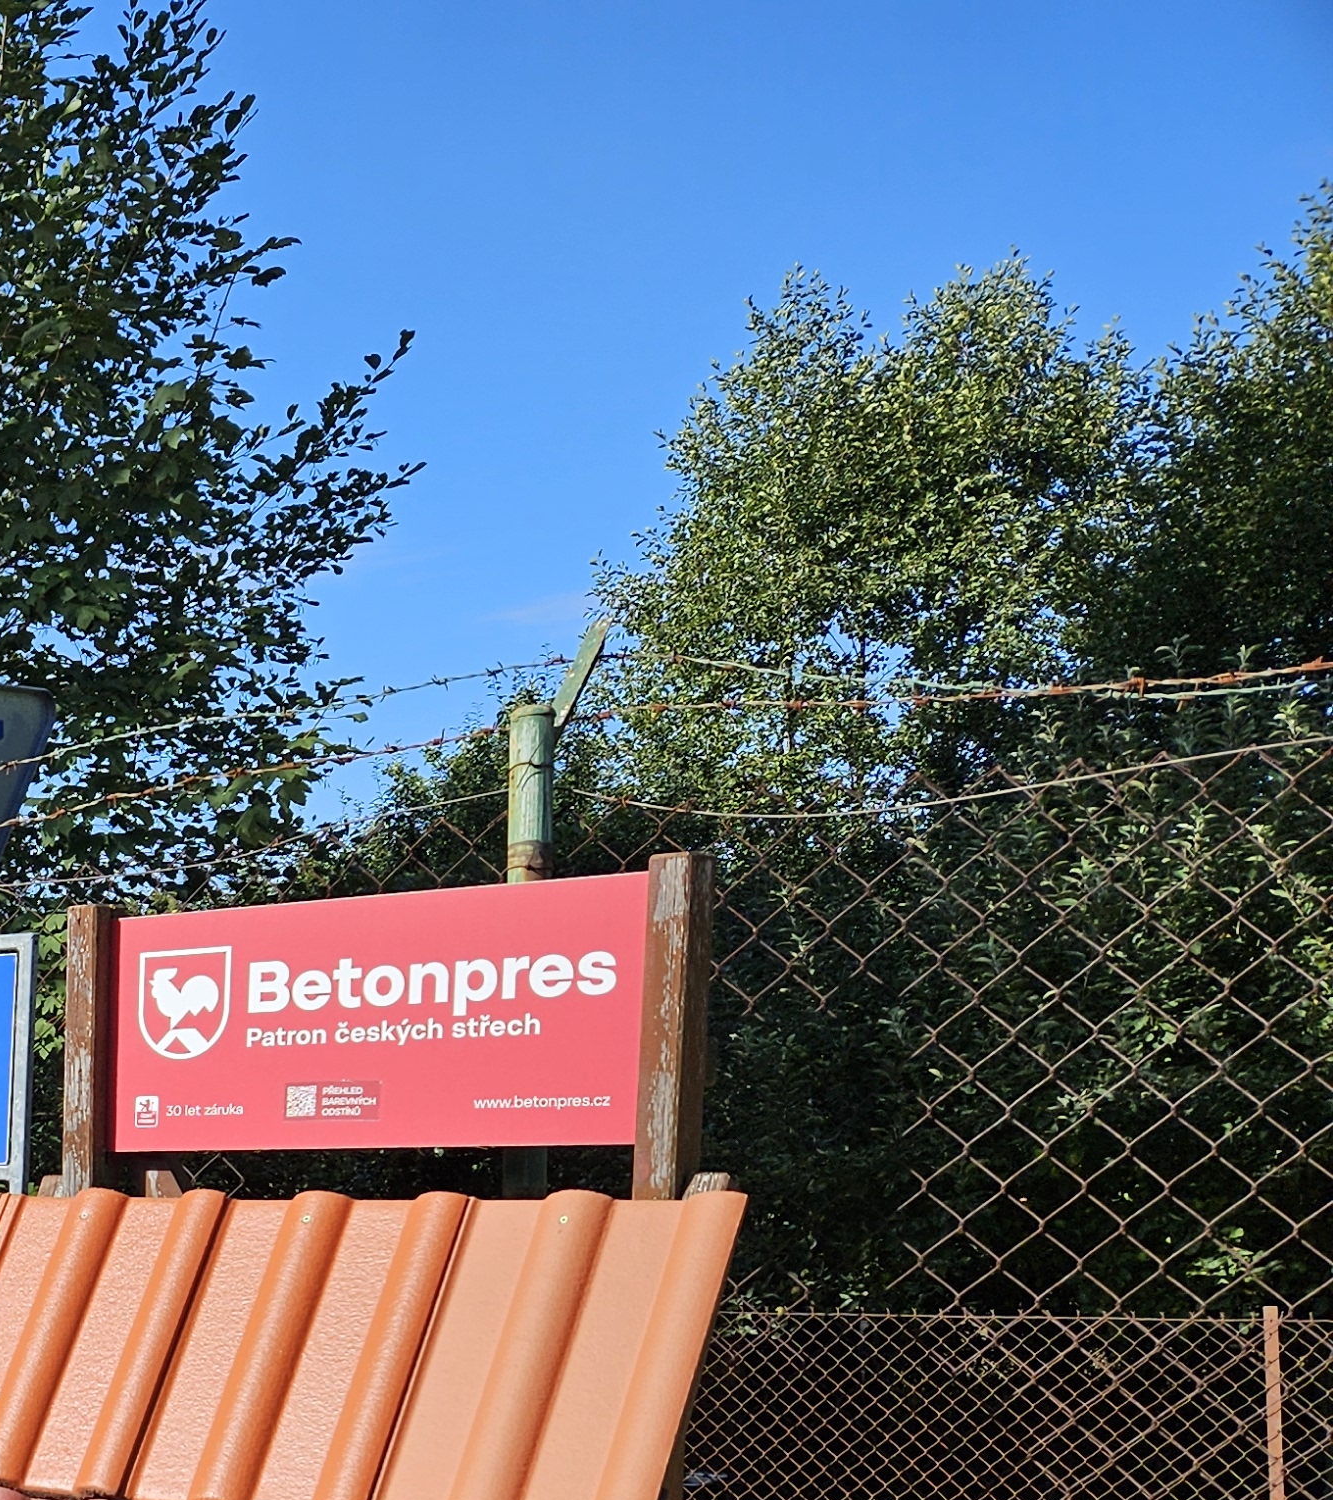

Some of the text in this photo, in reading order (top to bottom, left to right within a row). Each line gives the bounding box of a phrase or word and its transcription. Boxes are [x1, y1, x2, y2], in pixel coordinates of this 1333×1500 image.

[247, 950, 617, 1016] Betonpres
[246, 1012, 540, 1048] Patron českých střech
[322, 1085, 364, 1095] PŘEHLED
[322, 1095, 377, 1106] BAREVNÝCH
[474, 1095, 611, 1110] www.betonpres.cz
[165, 1103, 244, 1117] 30 let záruka
[322, 1106, 361, 1117] ODSTÍNŮ
